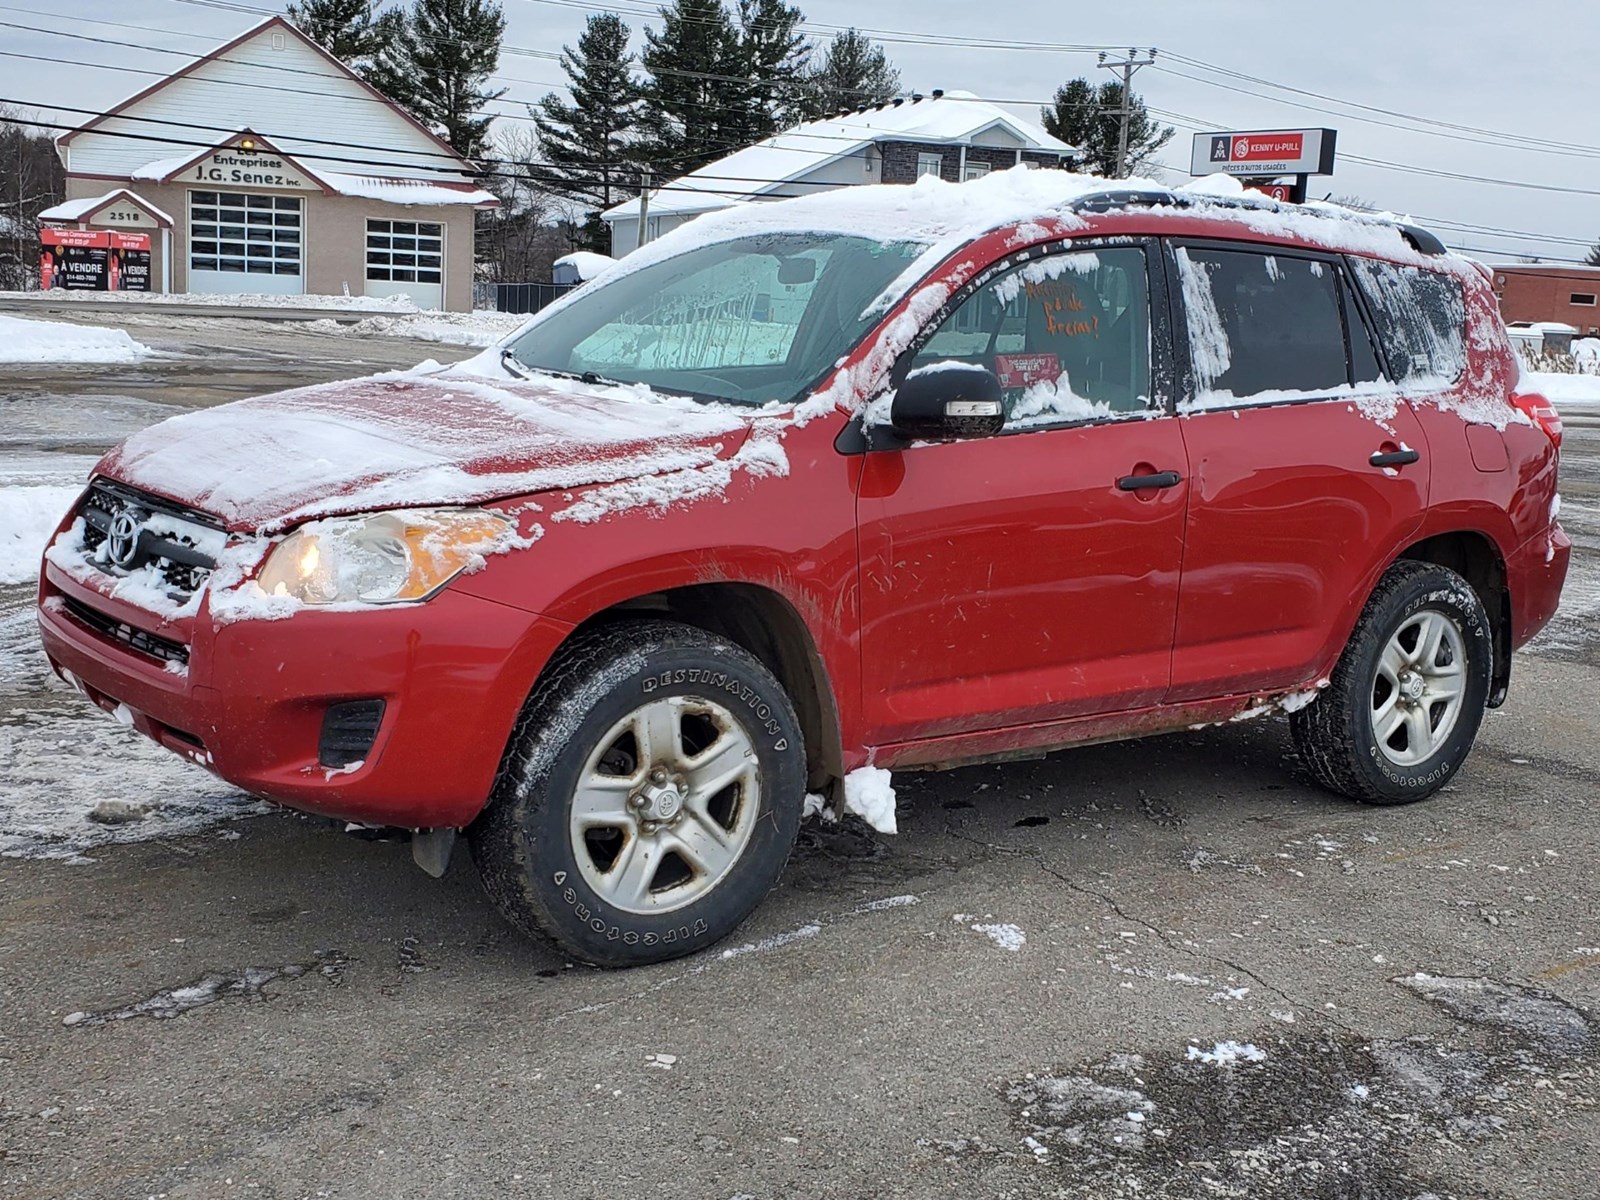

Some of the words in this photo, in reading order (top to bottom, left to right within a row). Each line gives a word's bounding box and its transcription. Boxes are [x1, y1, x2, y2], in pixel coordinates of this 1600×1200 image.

[1250, 145, 1275, 153] KENNY
[1275, 142, 1300, 152] U-PULL
[213, 155, 282, 168] Entreprises
[195, 165, 228, 182] J.G.
[231, 169, 284, 185] Senez
[286, 178, 302, 187] inc.
[110, 212, 140, 221] 2518
[61, 260, 67, 271] À
[69, 262, 103, 273] VENDRE
[127, 266, 148, 275] VENDRE
[642, 668, 780, 735] DESTINATION
